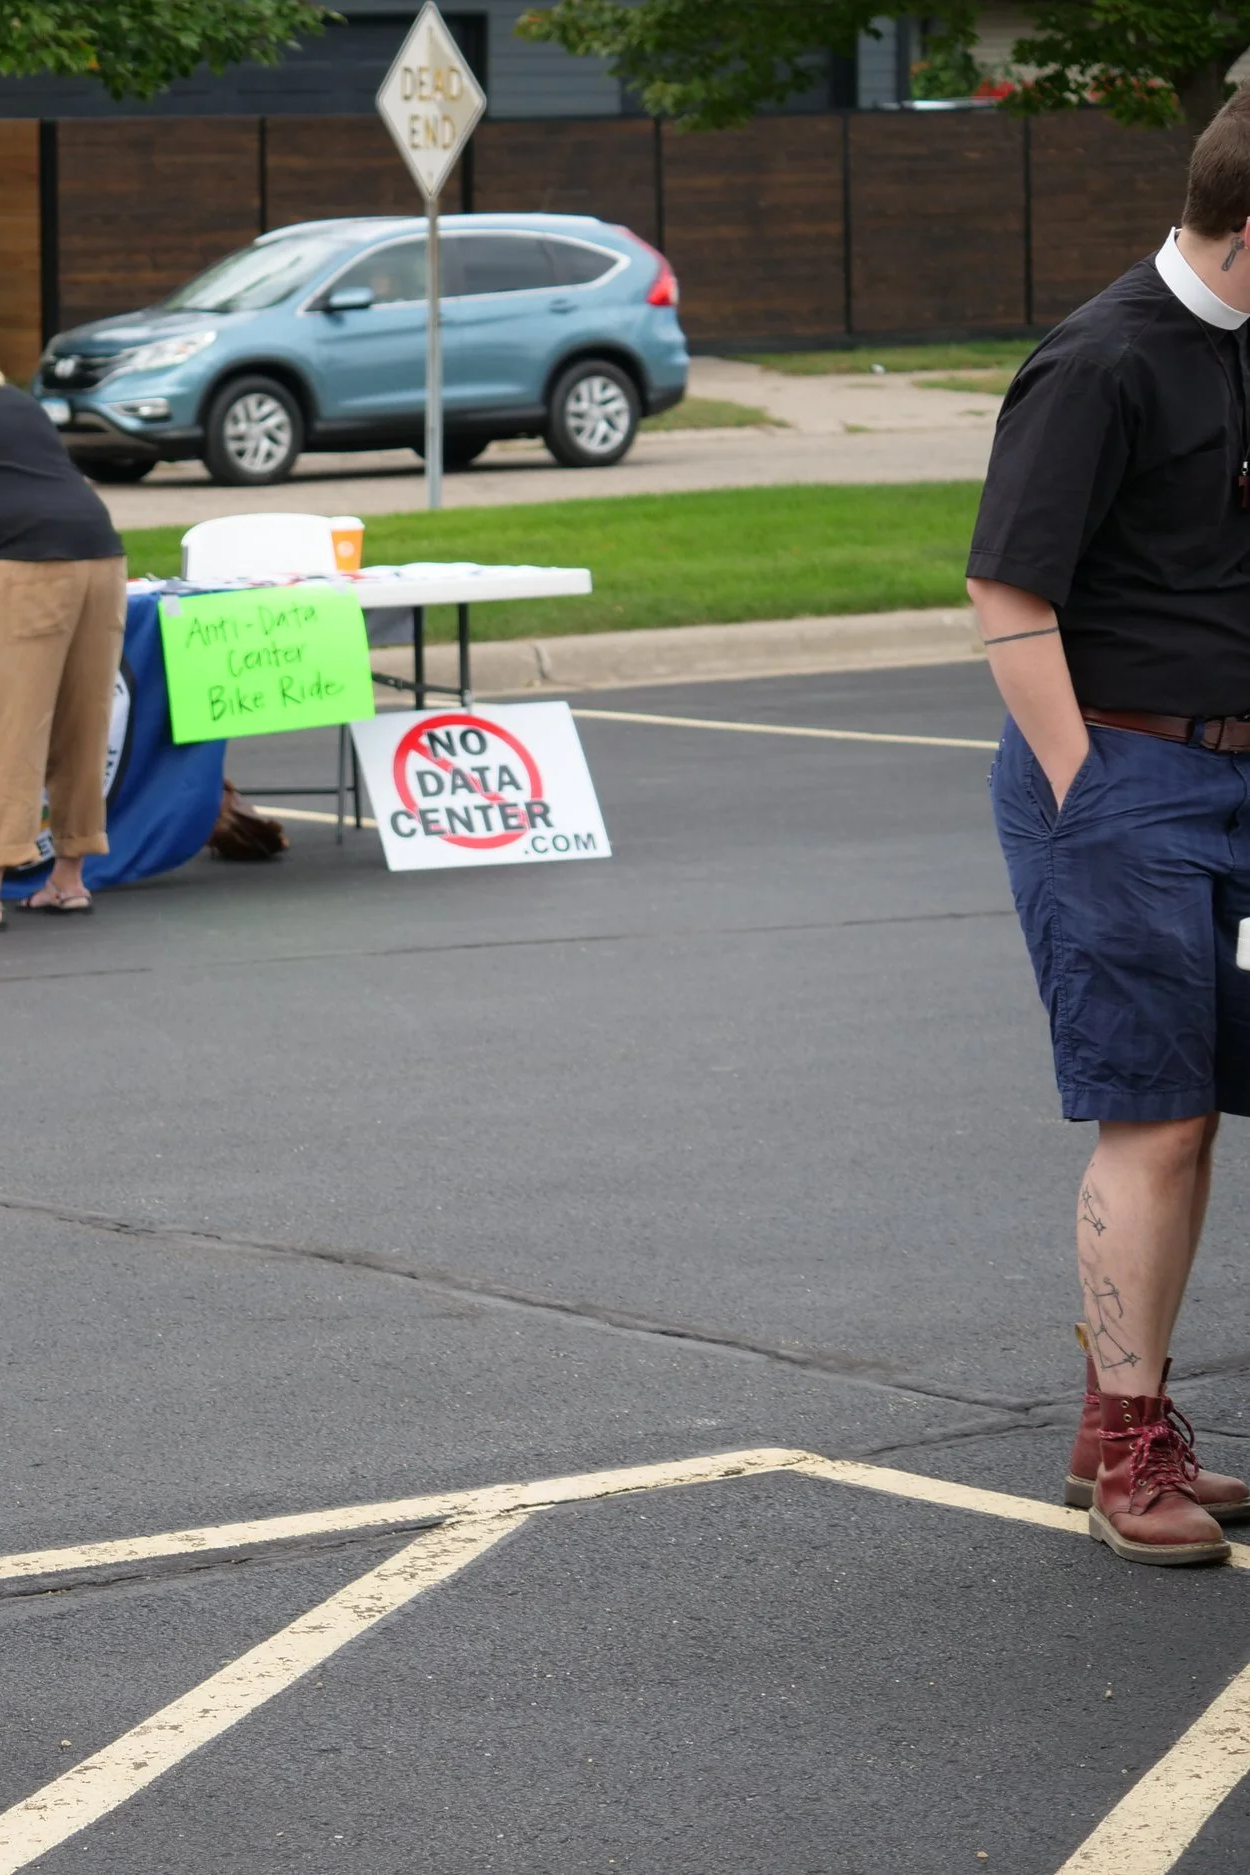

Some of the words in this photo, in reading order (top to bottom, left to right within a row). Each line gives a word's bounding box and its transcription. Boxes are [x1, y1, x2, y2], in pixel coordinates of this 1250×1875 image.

[402, 65, 464, 102] DEAD
[408, 113, 457, 150] END
[207, 685, 265, 722] Bike
[279, 672, 345, 708] Ride
[425, 728, 488, 759] NO
[415, 764, 522, 798] DATA
[390, 801, 554, 838] CENTER
[524, 832, 598, 854] .COM
